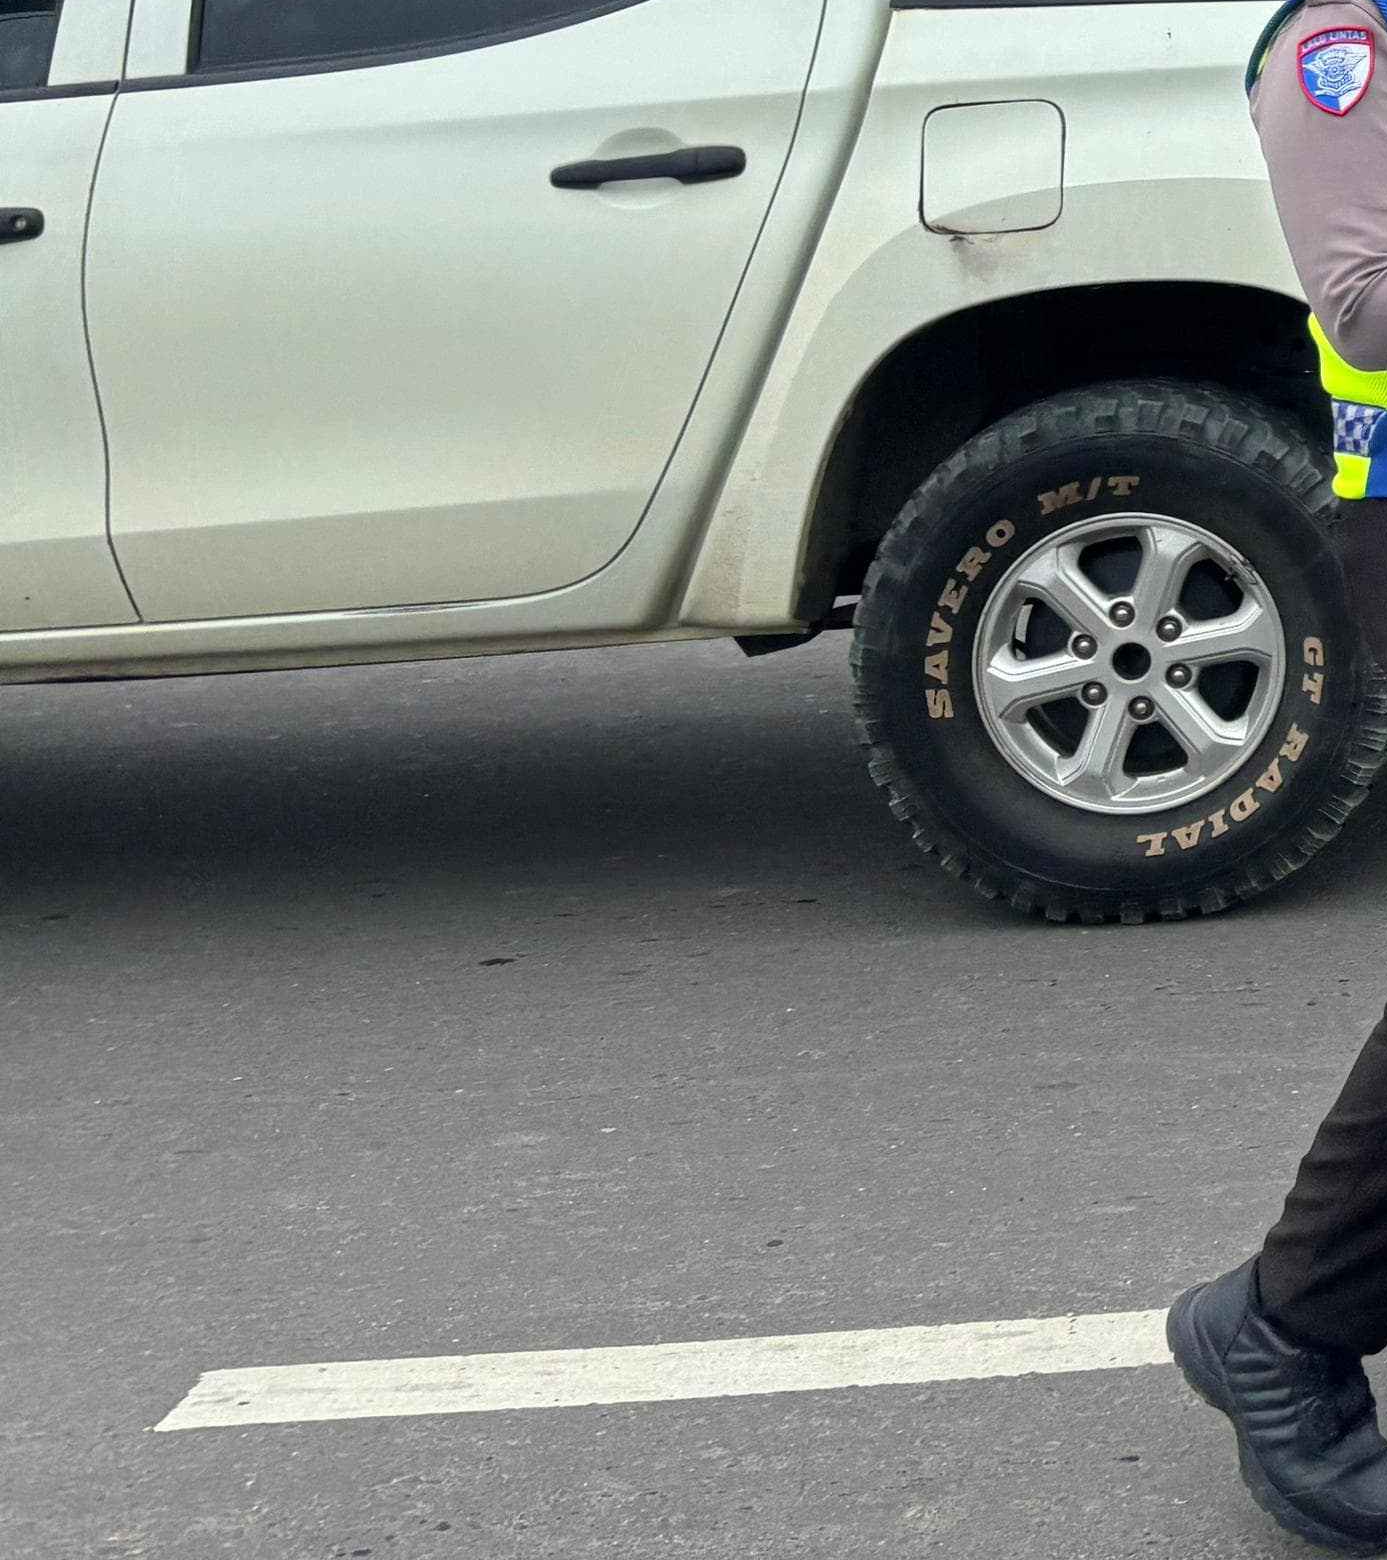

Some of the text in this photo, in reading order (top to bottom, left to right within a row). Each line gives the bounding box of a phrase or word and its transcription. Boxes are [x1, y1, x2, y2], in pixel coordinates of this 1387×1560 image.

[924, 476, 1140, 720] SAVERO M/T
[1136, 636, 1325, 857] GT RADIAL
